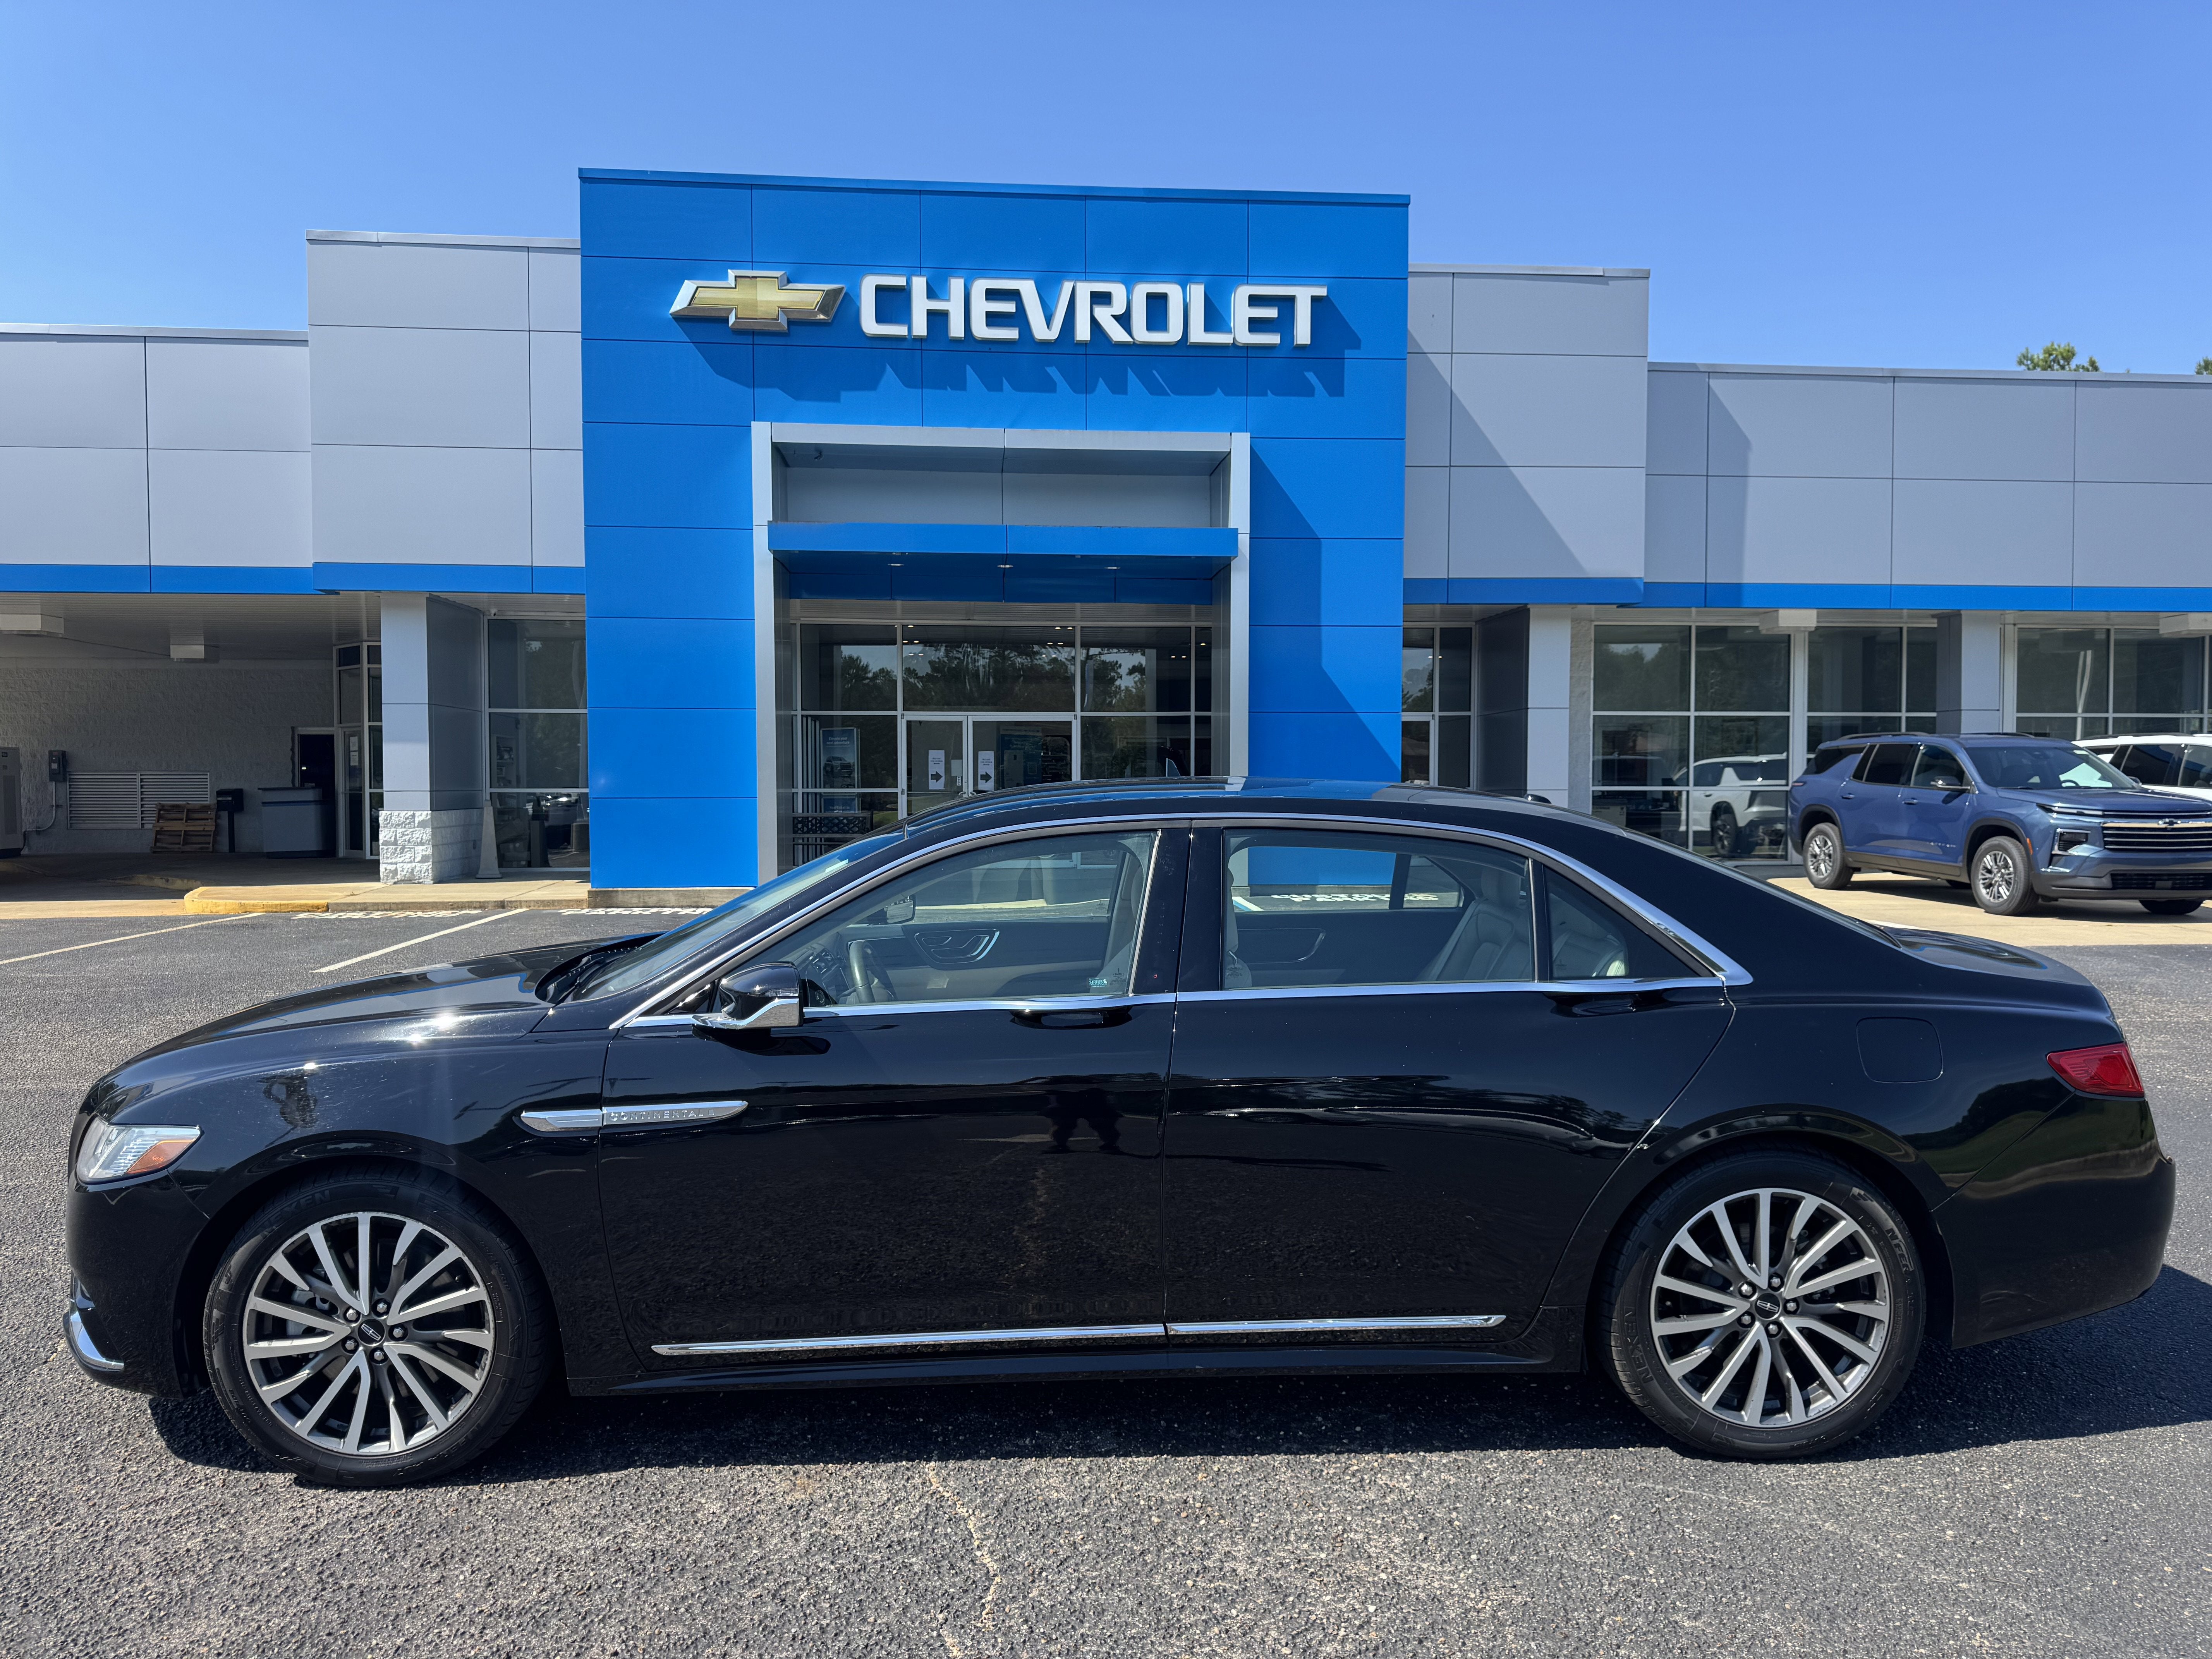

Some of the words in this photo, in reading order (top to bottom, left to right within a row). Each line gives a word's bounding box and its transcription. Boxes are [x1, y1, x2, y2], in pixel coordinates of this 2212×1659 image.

[860, 273, 1327, 346] CHEVROLET
[609, 1109, 704, 1121] CONTINENTAL
[1624, 1306, 1654, 1384] NEXEN
